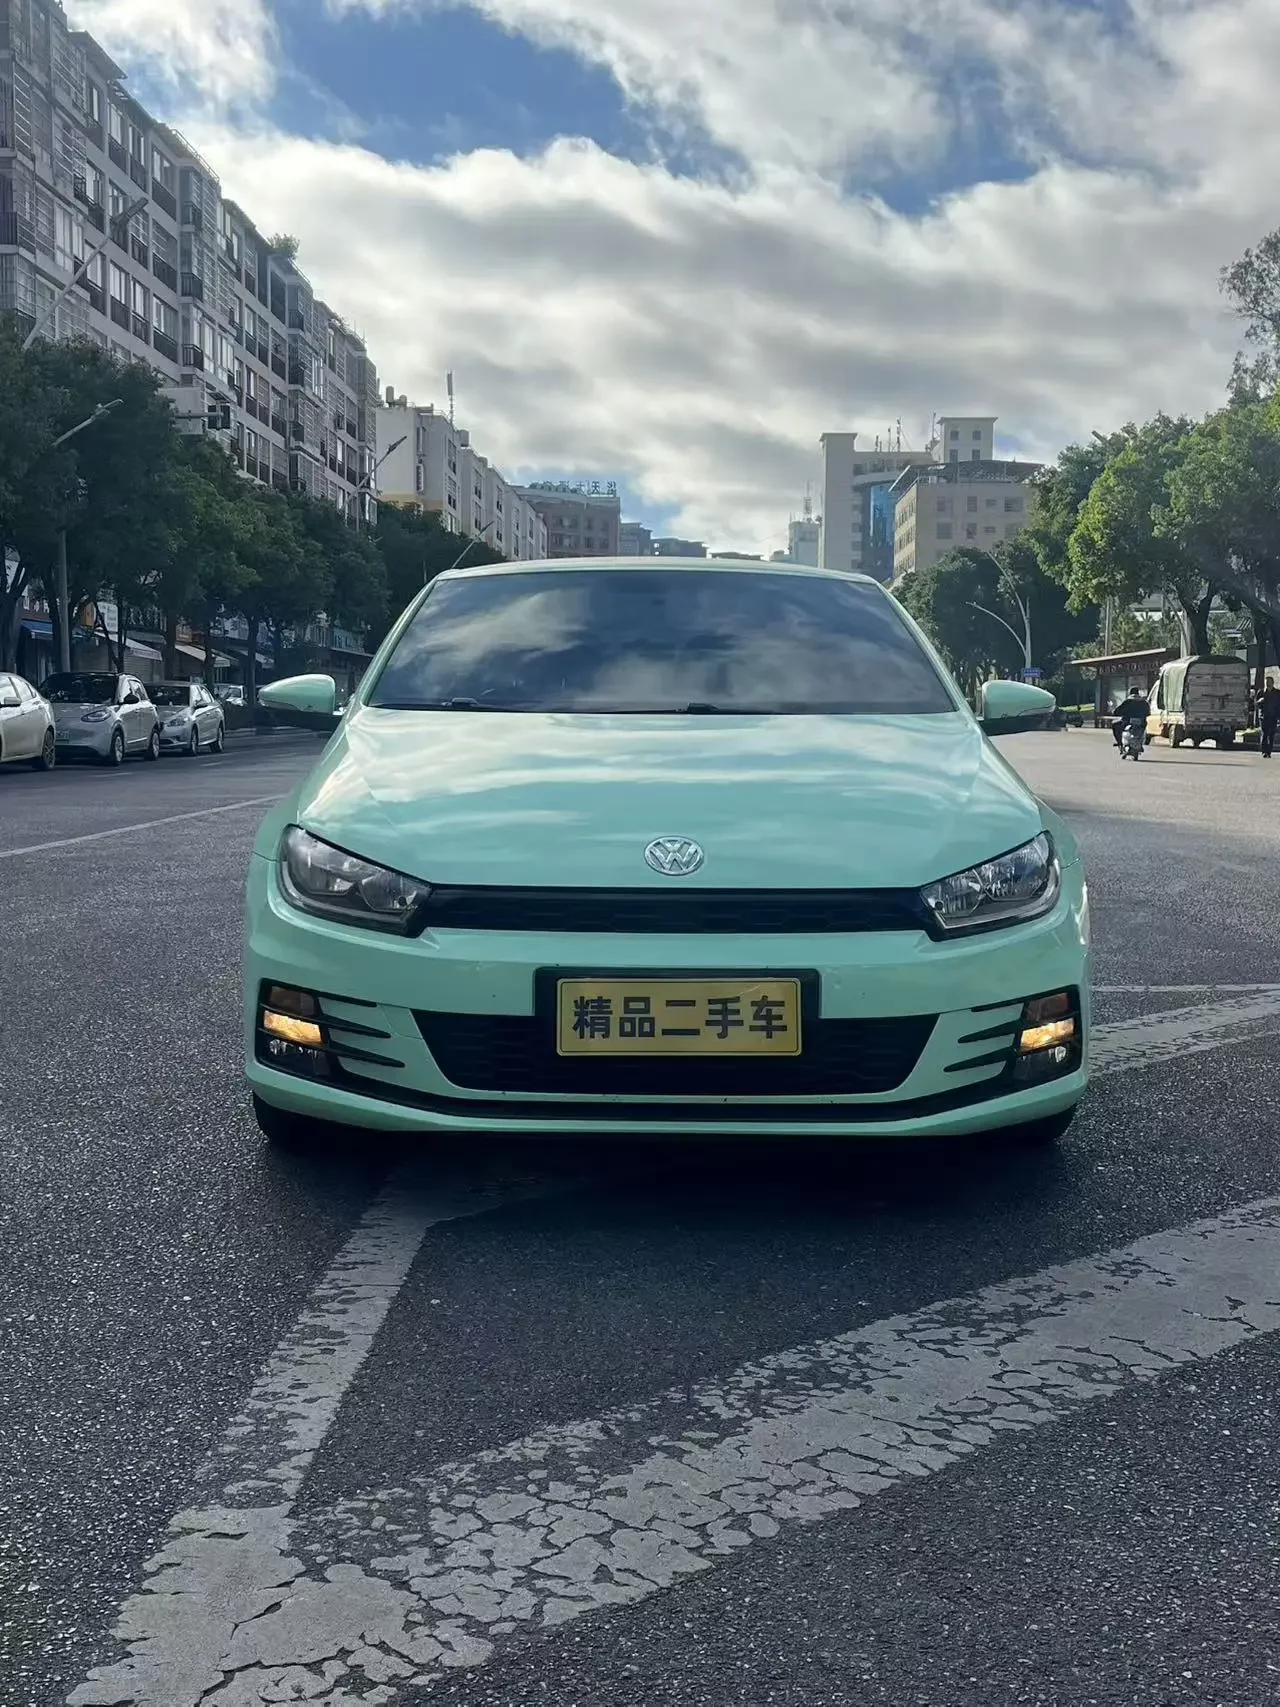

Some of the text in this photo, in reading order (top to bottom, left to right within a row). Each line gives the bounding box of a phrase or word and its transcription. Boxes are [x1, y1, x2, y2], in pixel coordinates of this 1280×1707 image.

[572, 995, 788, 1040] 精品二手车
